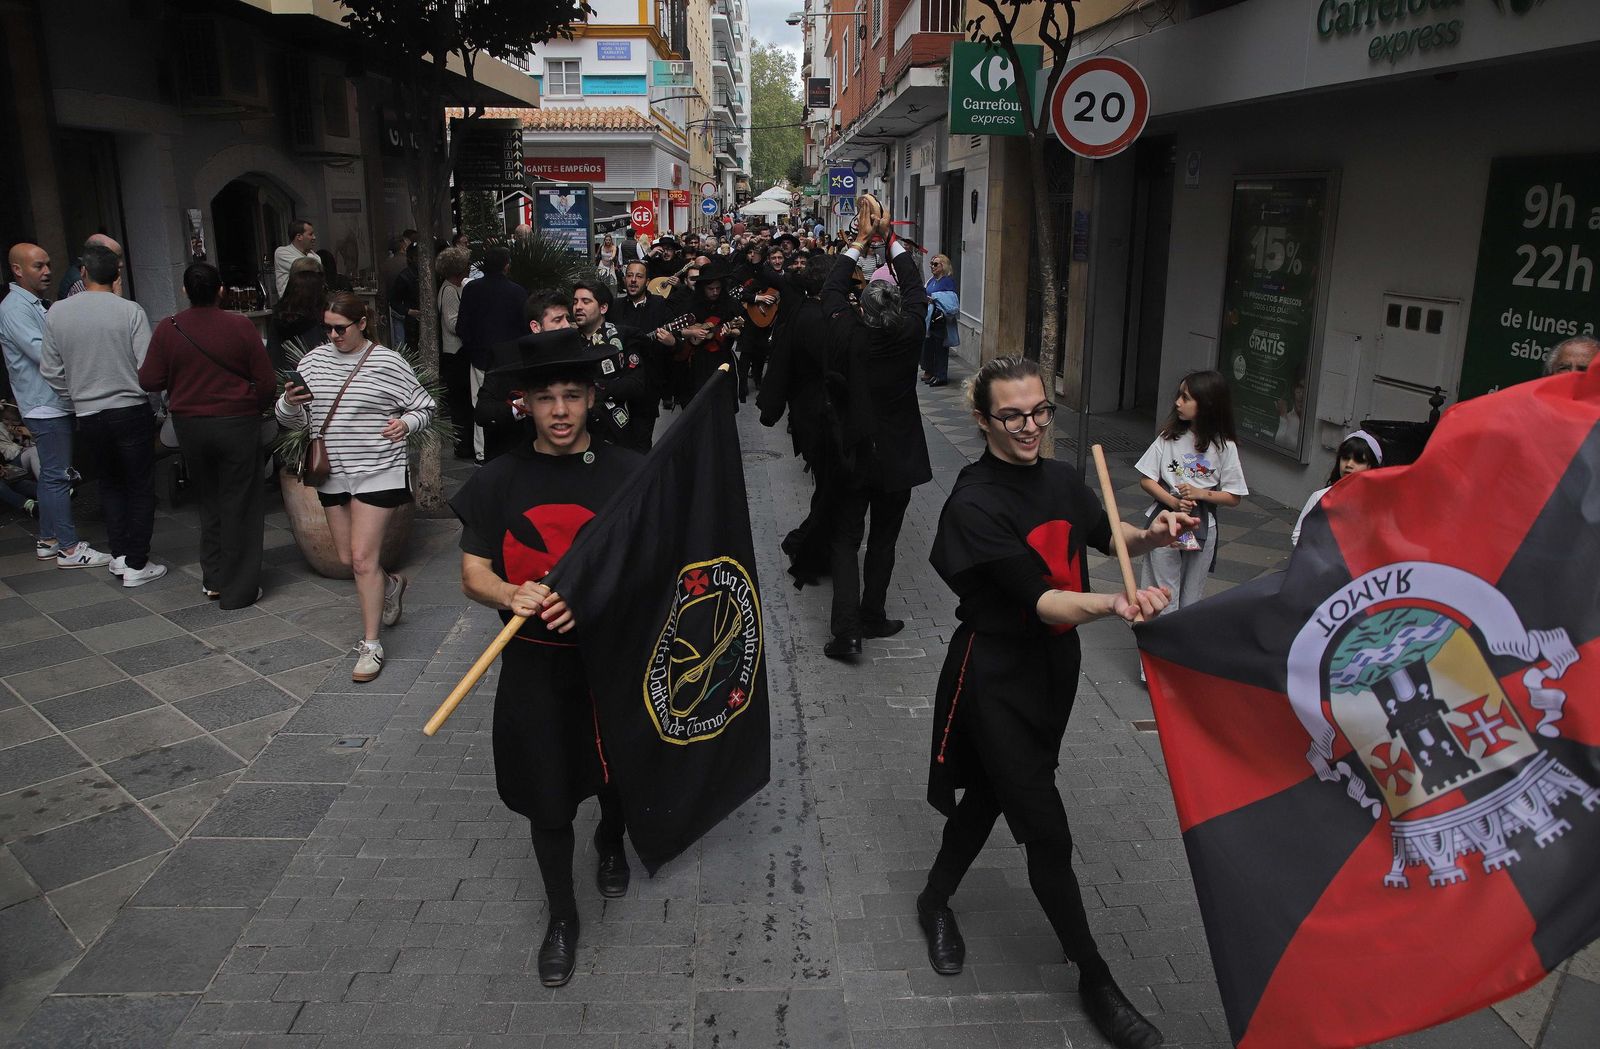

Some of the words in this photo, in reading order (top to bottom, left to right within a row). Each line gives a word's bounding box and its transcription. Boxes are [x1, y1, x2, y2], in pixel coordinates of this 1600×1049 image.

[1368, 19, 1463, 65] express
[962, 97, 1022, 112] Carrefou
[1074, 91, 1126, 122] 20
[971, 114, 1016, 126] express
[560, 164, 601, 174] EMPEÑOS
[634, 211, 650, 222] GE
[1522, 182, 1576, 229] 9h
[1512, 244, 1593, 293] 22h
[1500, 308, 1522, 329] de
[1526, 310, 1578, 336] lunes
[1582, 322, 1595, 335] a
[1248, 334, 1286, 356] GRATIS
[667, 716, 686, 736] de
[686, 708, 728, 738] Tomar
